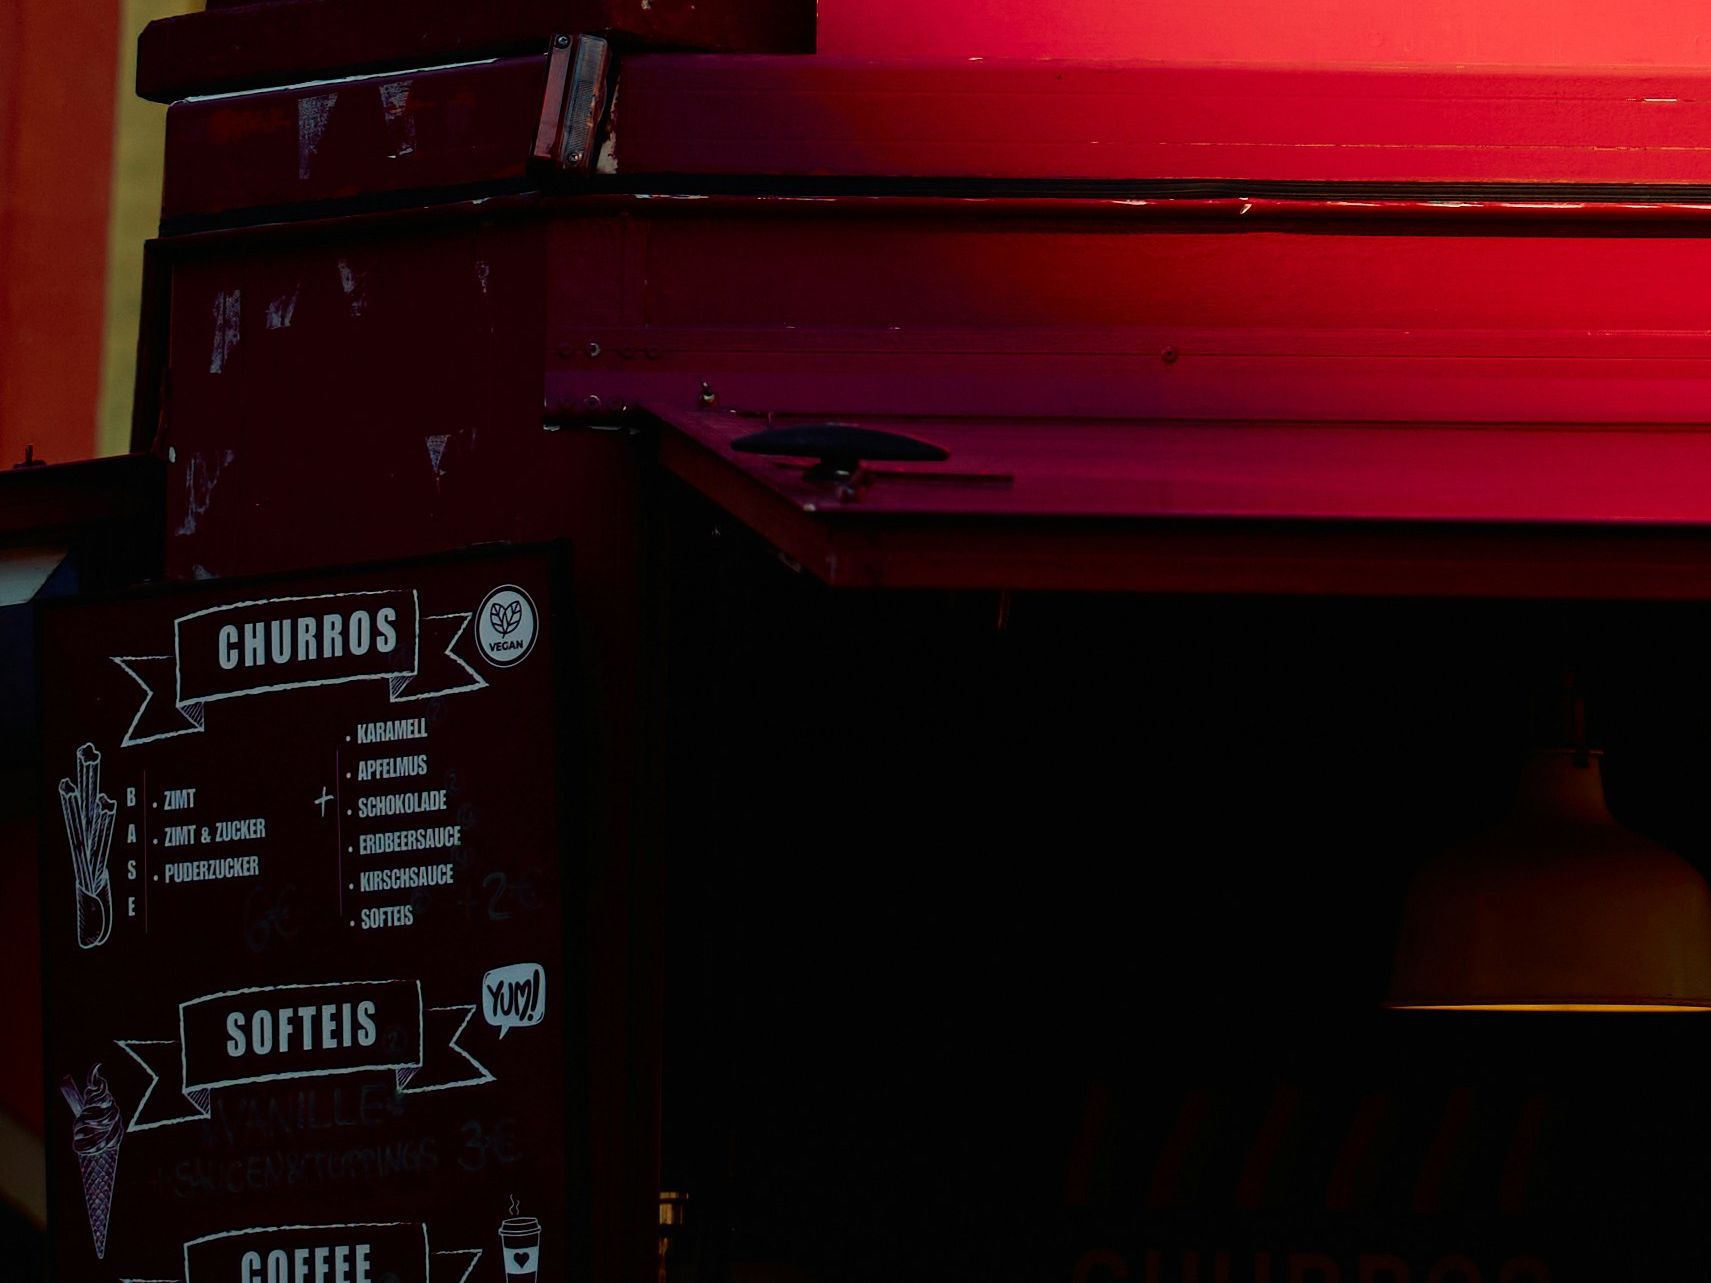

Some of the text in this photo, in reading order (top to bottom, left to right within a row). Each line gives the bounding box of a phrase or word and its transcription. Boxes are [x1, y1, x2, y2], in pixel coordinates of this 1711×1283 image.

[217, 607, 398, 670] CHURROS
[489, 638, 524, 652] VEGAN
[357, 717, 428, 744] KARAMELL
[358, 754, 427, 781] APFELMUS
[164, 788, 196, 811] ZIMT
[358, 789, 447, 818] SCHOKOLADE
[164, 818, 266, 847] ZIMT & ZUCKER
[359, 825, 461, 855] ERDBEERSAUCE
[165, 856, 259, 883] PUDERZUCKER
[360, 863, 454, 892] KIRSCHSAUCE
[361, 904, 414, 930] SOFTEIS
[226, 1000, 377, 1057] SOFTEIS
[240, 1244, 372, 1283] COFFEE
